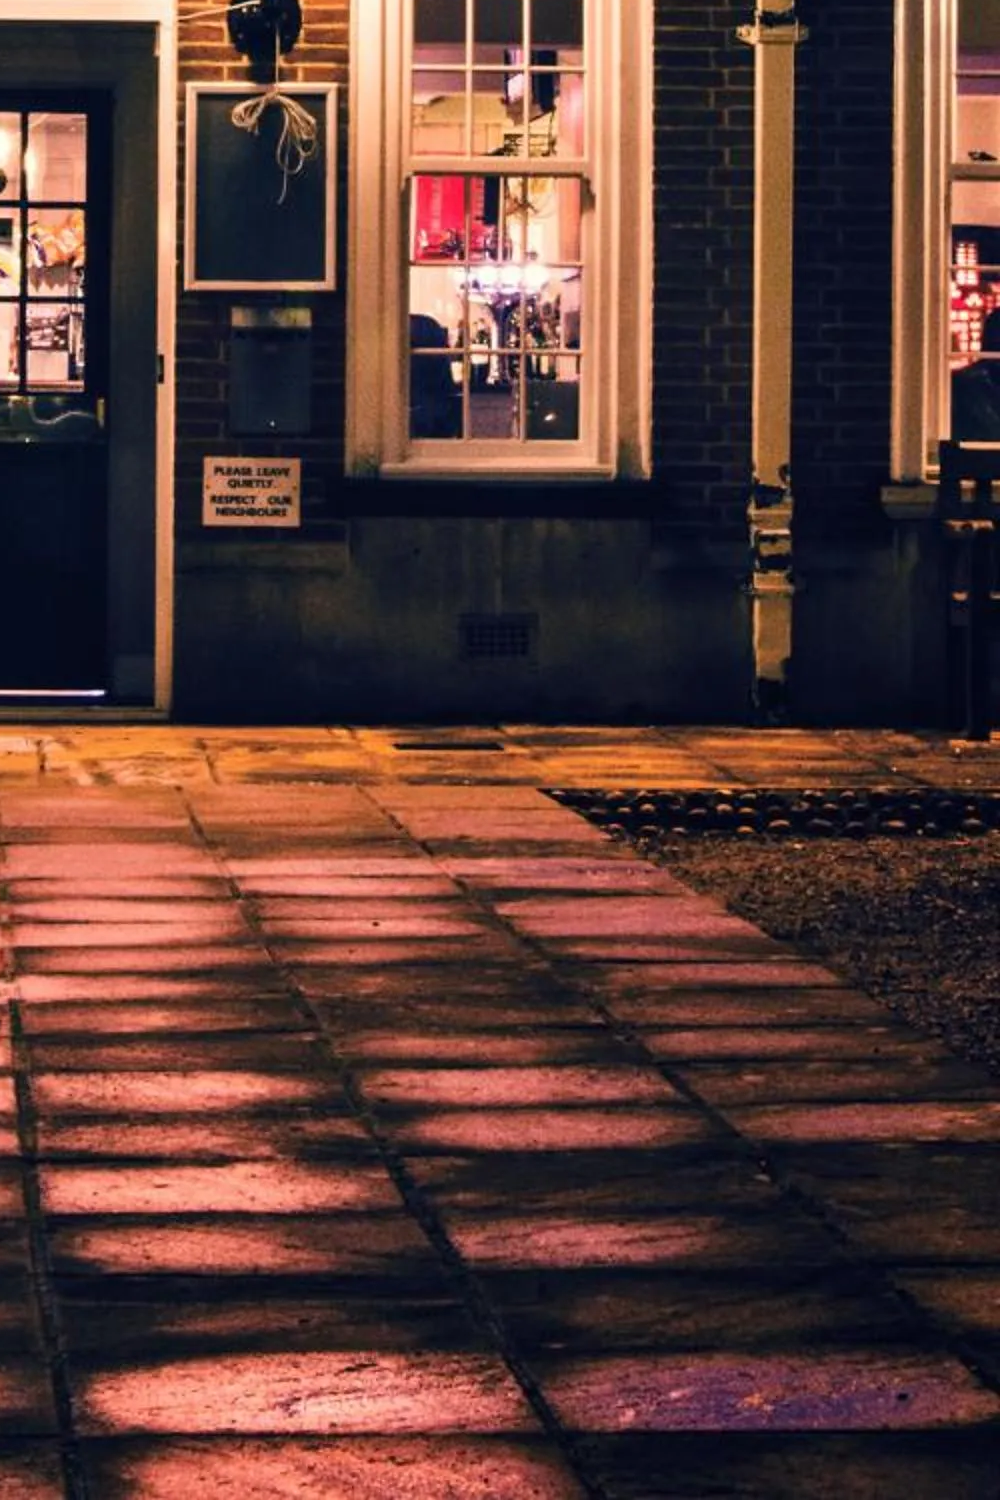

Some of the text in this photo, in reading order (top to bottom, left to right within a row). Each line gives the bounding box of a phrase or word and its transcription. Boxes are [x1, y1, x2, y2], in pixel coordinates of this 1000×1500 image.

[213, 466, 290, 476] PLEASE LEAVE
[211, 495, 292, 505] RESPECT OUR
[216, 508, 287, 516] NEIGHBOURS
